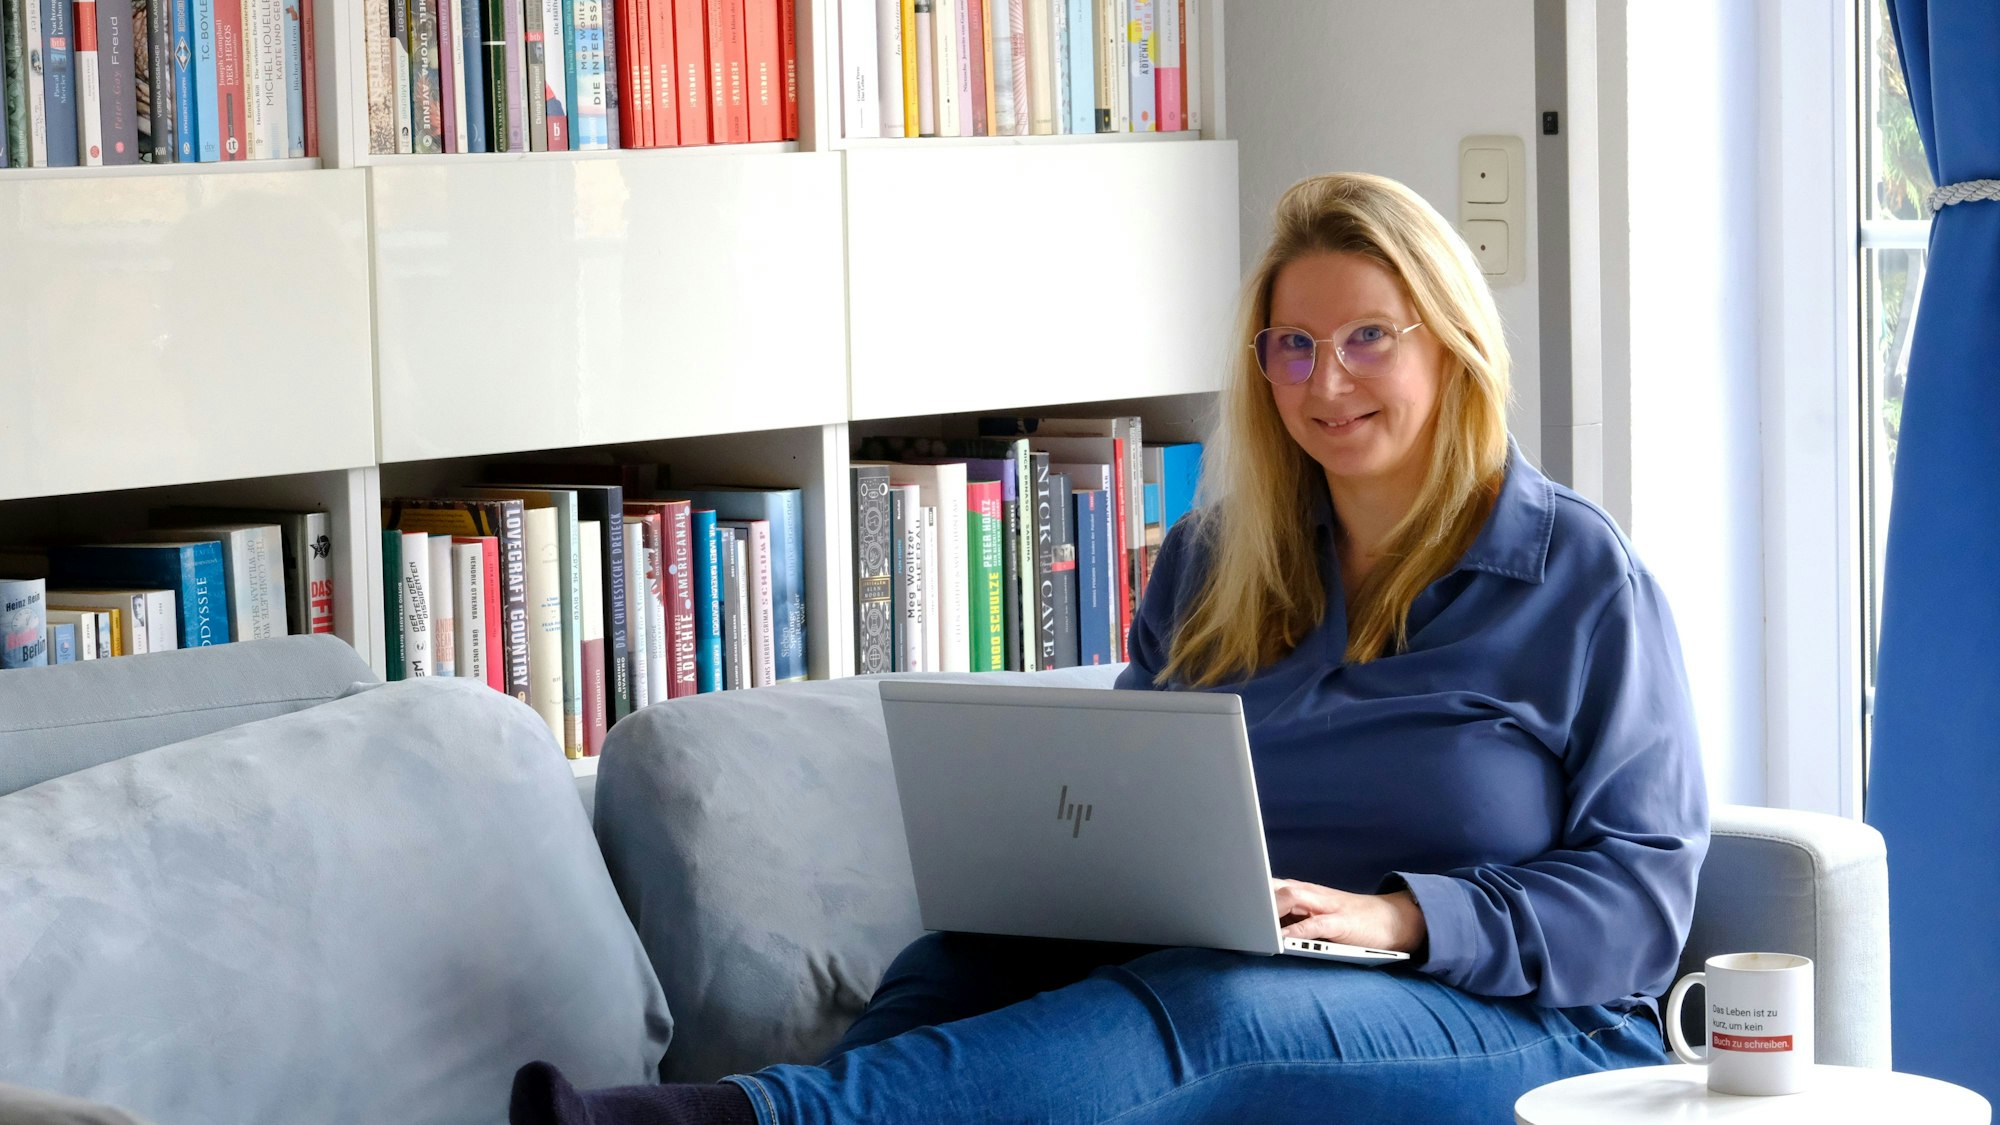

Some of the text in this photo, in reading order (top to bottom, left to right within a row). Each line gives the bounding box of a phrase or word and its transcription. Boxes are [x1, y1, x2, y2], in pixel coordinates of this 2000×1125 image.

[56, 2, 64, 35] Lissabon
[199, 0, 209, 40] BOYLE
[273, 1, 283, 80] KARTE UND GEB
[398, 0, 406, 32] Green
[578, 1, 588, 70] Meg Wolitz
[110, 16, 123, 130] Peter Gay Freud
[154, 45, 162, 90] ROSSBACHER
[224, 24, 234, 86] DER HEROS
[1140, 39, 1149, 75] ADICHIE
[263, 57, 274, 106] MICHEL
[592, 82, 601, 105] DIE
[676, 513, 689, 600] AMERICANAH
[981, 500, 993, 569] PETER HOLTZ
[1037, 462, 1055, 657] NICK CAVE
[247, 539, 262, 640] OF WILLIAM SHAKE
[256, 538, 271, 640] THE COMPLETE WO
[311, 579, 333, 598] DAS
[409, 562, 429, 620] DISSIDENTEN
[573, 572, 578, 583] ME
[612, 513, 625, 649] DAS CHINESISCHE DREIECK
[759, 532, 768, 607] SCHLUMP
[906, 530, 916, 620] Meg Wolitzer
[6, 592, 41, 612] Heinz Rein
[405, 577, 426, 633] GARTEN DER
[506, 508, 528, 687] LOVECRAFT COUNTRY
[793, 595, 801, 610] der
[990, 573, 1001, 671] INGO SCHULZE
[22, 636, 46, 662] Berlin
[408, 615, 420, 634] DER
[682, 613, 695, 684] ADICHIE
[780, 628, 790, 659] Sieben
[787, 611, 797, 651] Sprünge
[794, 611, 802, 637] Rand
[674, 615, 684, 685] CHIMAMANDA NGOZI
[594, 669, 603, 728] Flammarion
[764, 667, 772, 687] HANS
[1057, 785, 1092, 838] hp
[1712, 1004, 1778, 1018] Das Leben ist zu
[1712, 1019, 1763, 1032] kurz, um kein
[1713, 1035, 1790, 1049] Buch zu schreiben.
